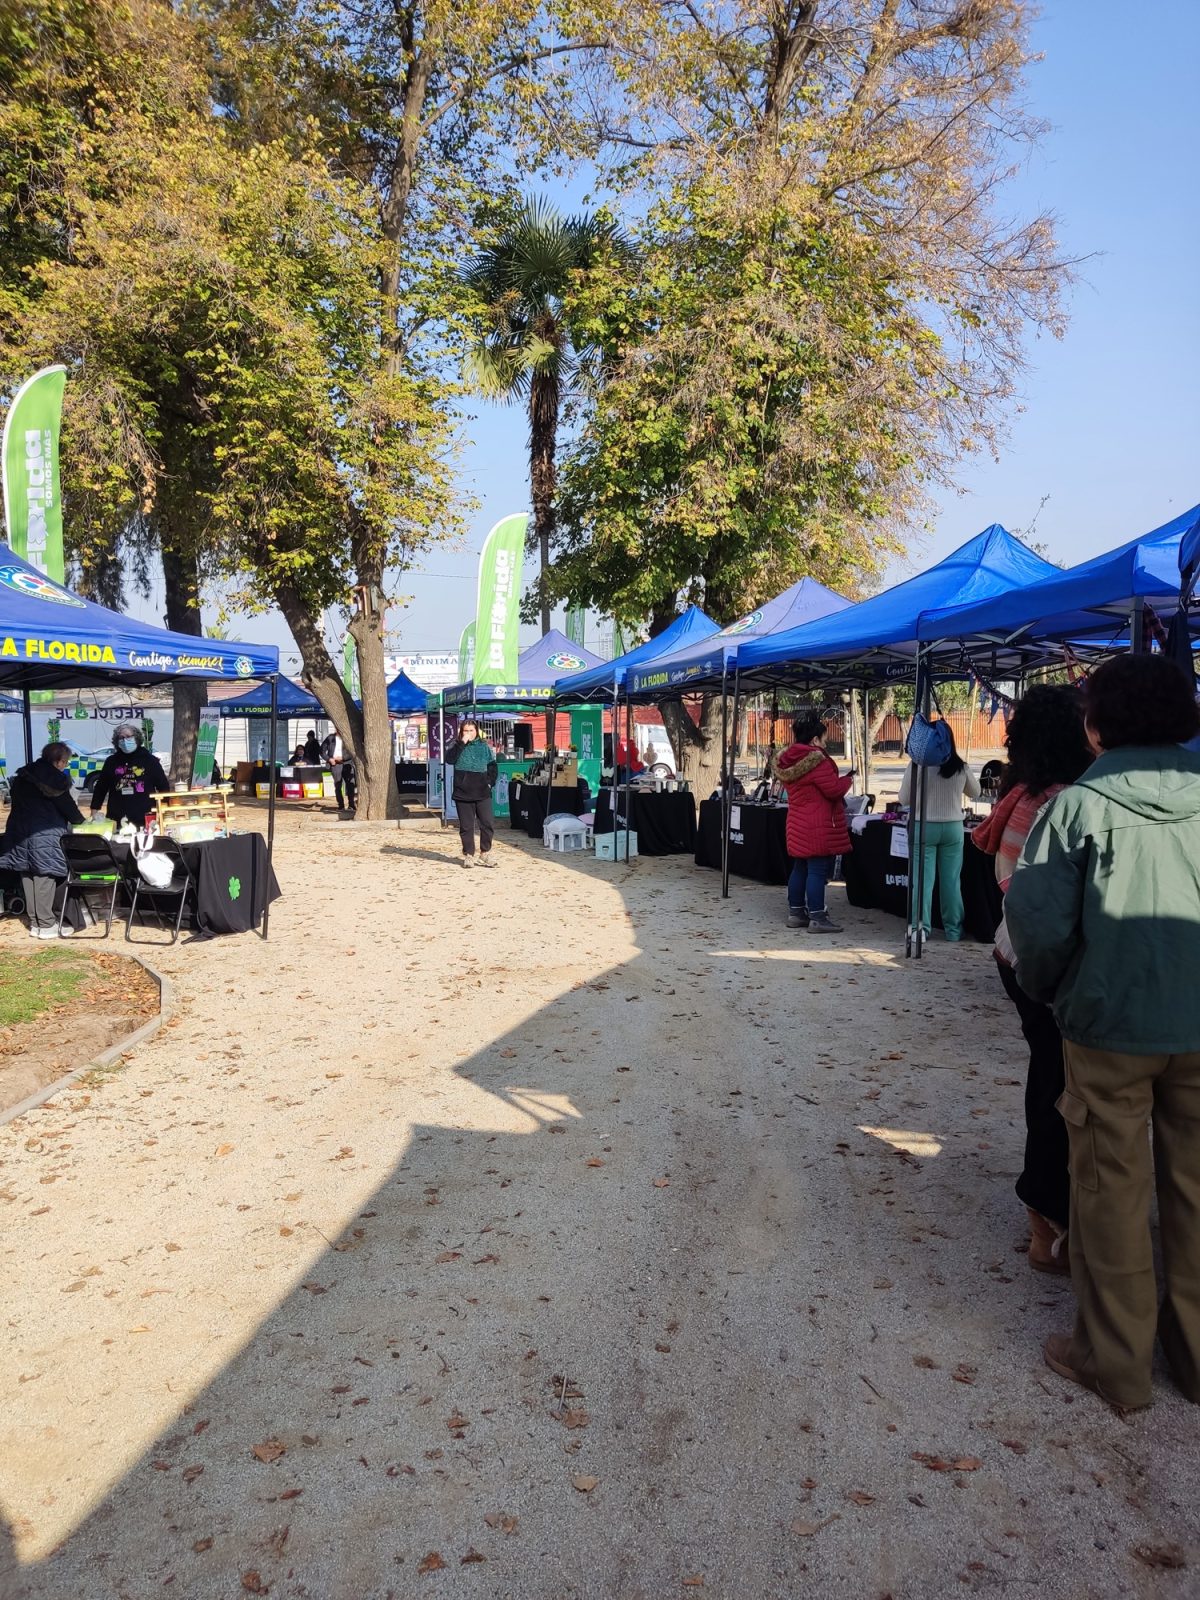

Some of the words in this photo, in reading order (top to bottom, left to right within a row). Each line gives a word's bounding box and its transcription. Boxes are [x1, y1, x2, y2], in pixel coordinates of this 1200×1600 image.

[45, 463, 53, 508] SOMOS
[490, 548, 511, 641] Florida
[0, 638, 19, 657] A
[25, 639, 117, 664] FLORIDA
[489, 642, 505, 670] La
[514, 688, 528, 697] LA
[641, 677, 648, 689] LA
[648, 671, 669, 687] FLORIDA
